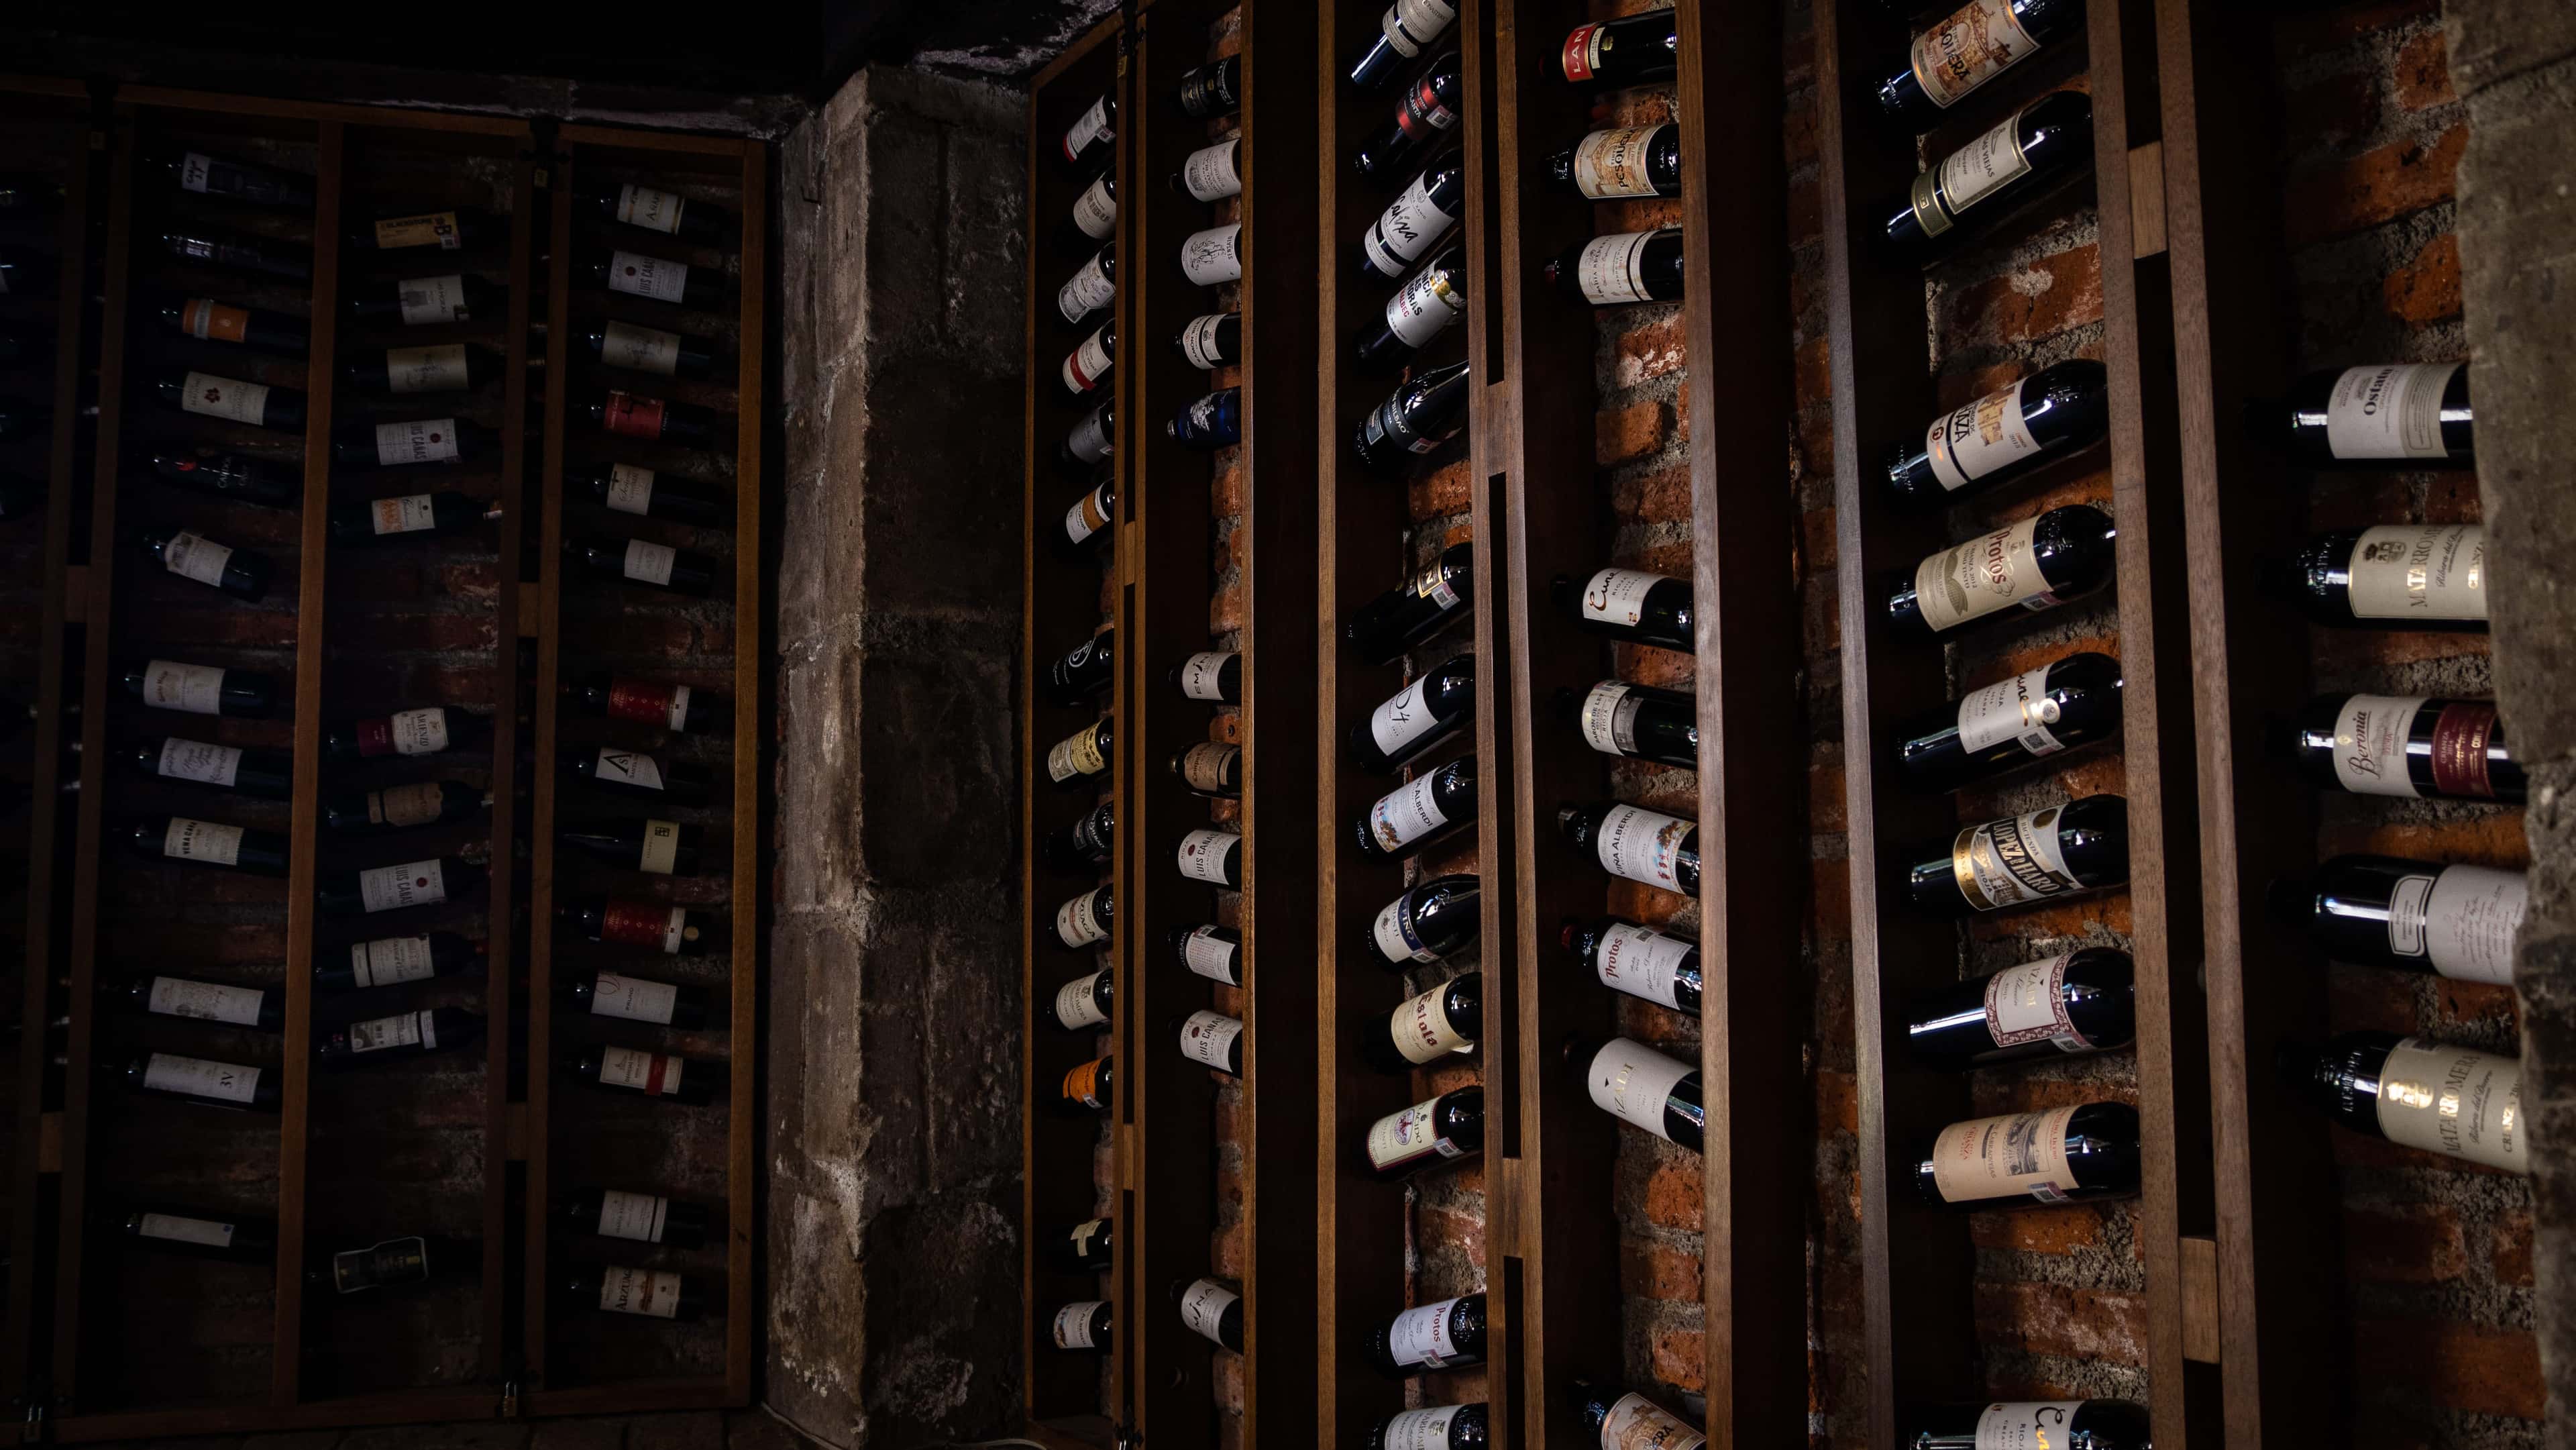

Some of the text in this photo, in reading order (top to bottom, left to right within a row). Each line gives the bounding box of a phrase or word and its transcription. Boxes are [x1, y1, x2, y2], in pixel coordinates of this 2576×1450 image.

[1572, 30, 1587, 73] LAN
[1951, 26, 1961, 49] TINTO
[1981, 147, 1995, 178] VIEJAS
[639, 278, 651, 295] LUIS
[1421, 270, 1433, 298] INCA
[1988, 531, 2010, 584] Protos
[2434, 554, 2451, 588] Ribera
[1589, 571, 1618, 611] Cune
[417, 713, 429, 747] ARIENZO
[2347, 711, 2380, 779] Beronia
[2440, 730, 2449, 764] CRIANZA
[1410, 789, 1433, 827] ALBERDI
[1612, 810, 1636, 851] ALBERDI
[2021, 821, 2041, 857] HACIENDA
[1197, 857, 1205, 876] LUIS
[1994, 823, 2015, 862] LOPEZ
[2019, 860, 2061, 896] HARO
[1980, 866, 1993, 893] RIOJA
[1605, 938, 1623, 982] Protos
[1201, 1040, 1210, 1061] LUIS
[220, 1072, 235, 1088] 3V
[1615, 1063, 1634, 1115] IZADI
[1434, 1306, 1446, 1343] Protos
